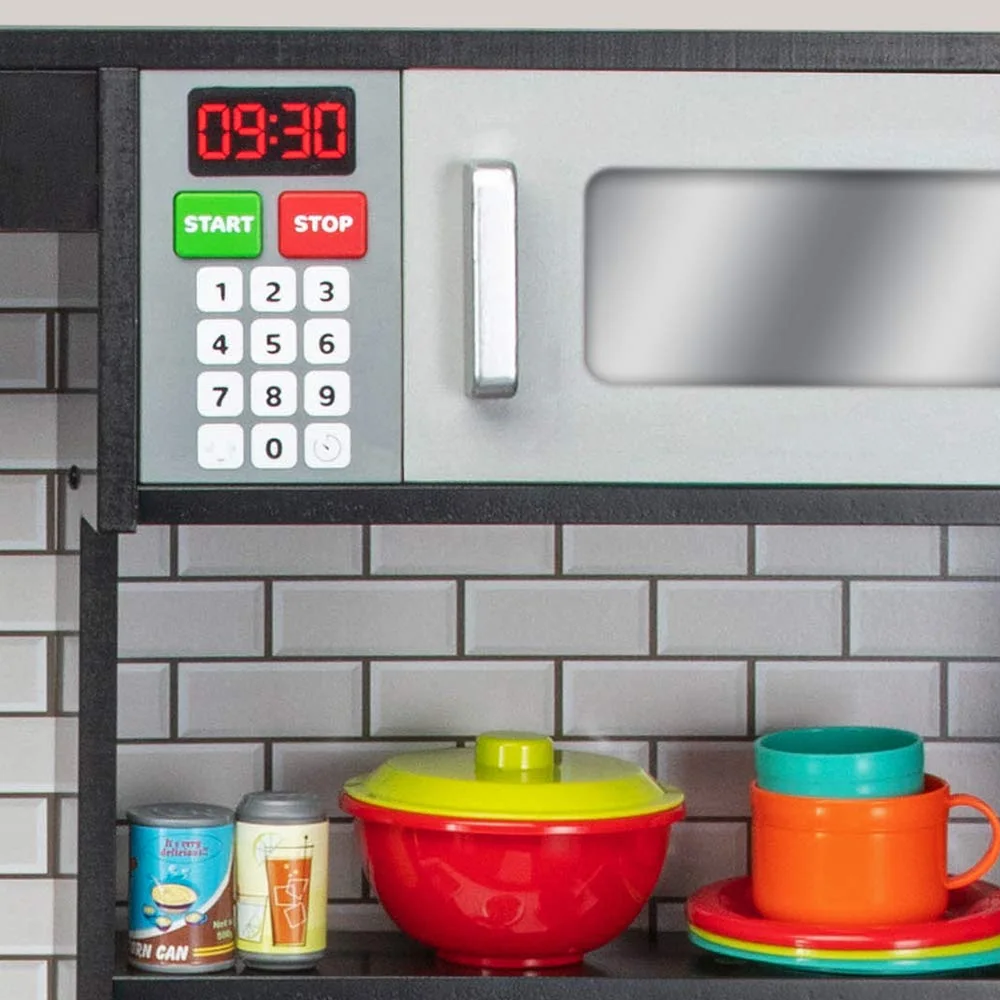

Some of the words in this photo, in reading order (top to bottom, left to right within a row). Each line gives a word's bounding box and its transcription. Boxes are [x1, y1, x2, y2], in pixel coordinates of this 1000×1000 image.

[197, 102, 347, 160] 09:30
[183, 214, 255, 234] START
[293, 214, 354, 234] STOP
[215, 282, 226, 302] 1
[265, 281, 281, 303] 2
[319, 280, 334, 303] 3
[212, 334, 229, 355] 4
[266, 333, 282, 355] 5
[318, 333, 335, 355] 6
[212, 386, 229, 408] 7
[265, 385, 282, 408] 8
[318, 385, 336, 407] 9
[265, 437, 283, 460] 0
[155, 944, 189, 961] CAN
